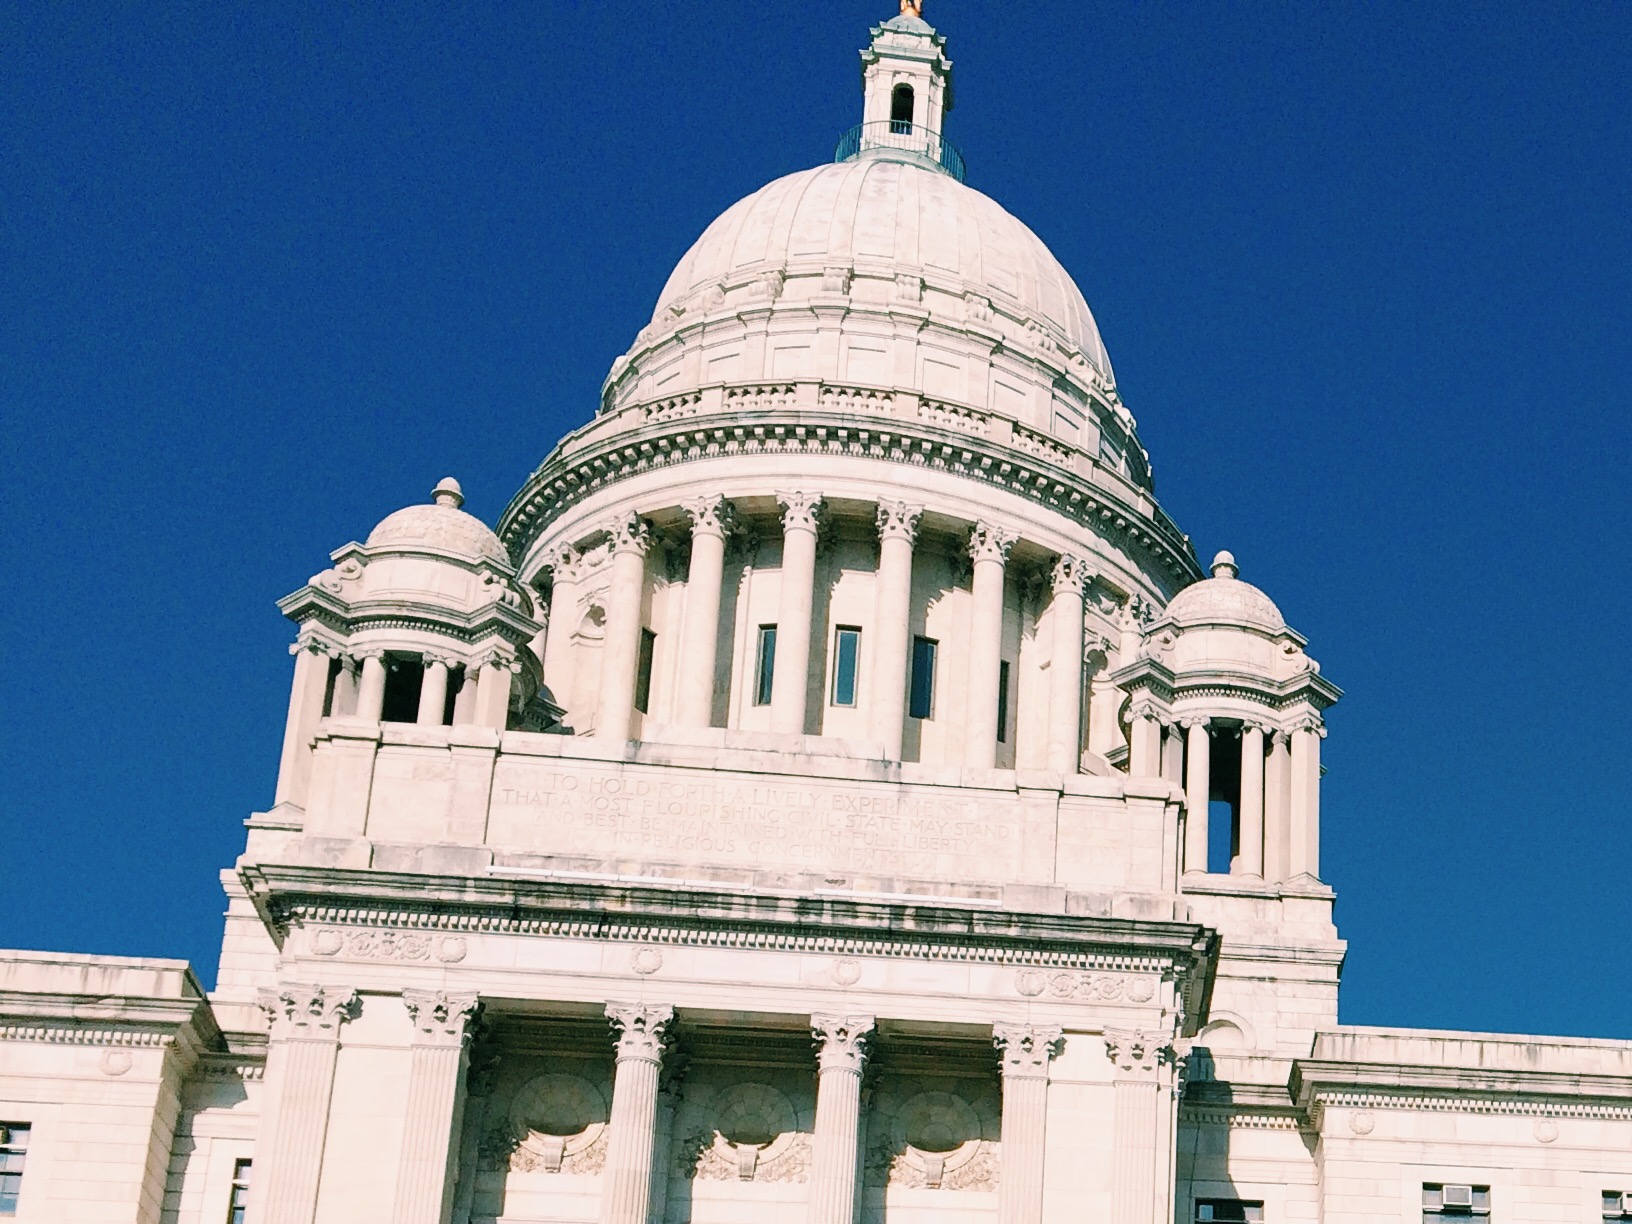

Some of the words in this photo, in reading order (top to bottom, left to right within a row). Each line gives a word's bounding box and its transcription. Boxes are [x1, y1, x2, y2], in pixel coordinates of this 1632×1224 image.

[502, 788, 555, 807] THAT
[560, 794, 573, 808] A
[580, 795, 635, 811] MOST
[788, 810, 836, 827] CIVIL
[845, 814, 901, 832] STATE
[909, 818, 949, 835] MAY
[954, 821, 1010, 839] STAND
[546, 773, 579, 791] TO
[589, 776, 651, 796] HOLD
[659, 782, 725, 804] FORTH
[732, 788, 746, 804] A
[753, 788, 822, 809] LIVELY
[832, 794, 969, 817] EXPERIMENT
[535, 810, 575, 824] AND
[583, 812, 631, 828] BEST
[639, 816, 662, 831] BE
[796, 828, 842, 844] WITH
[903, 835, 975, 852] LIBERTY
[613, 831, 631, 845] IN
